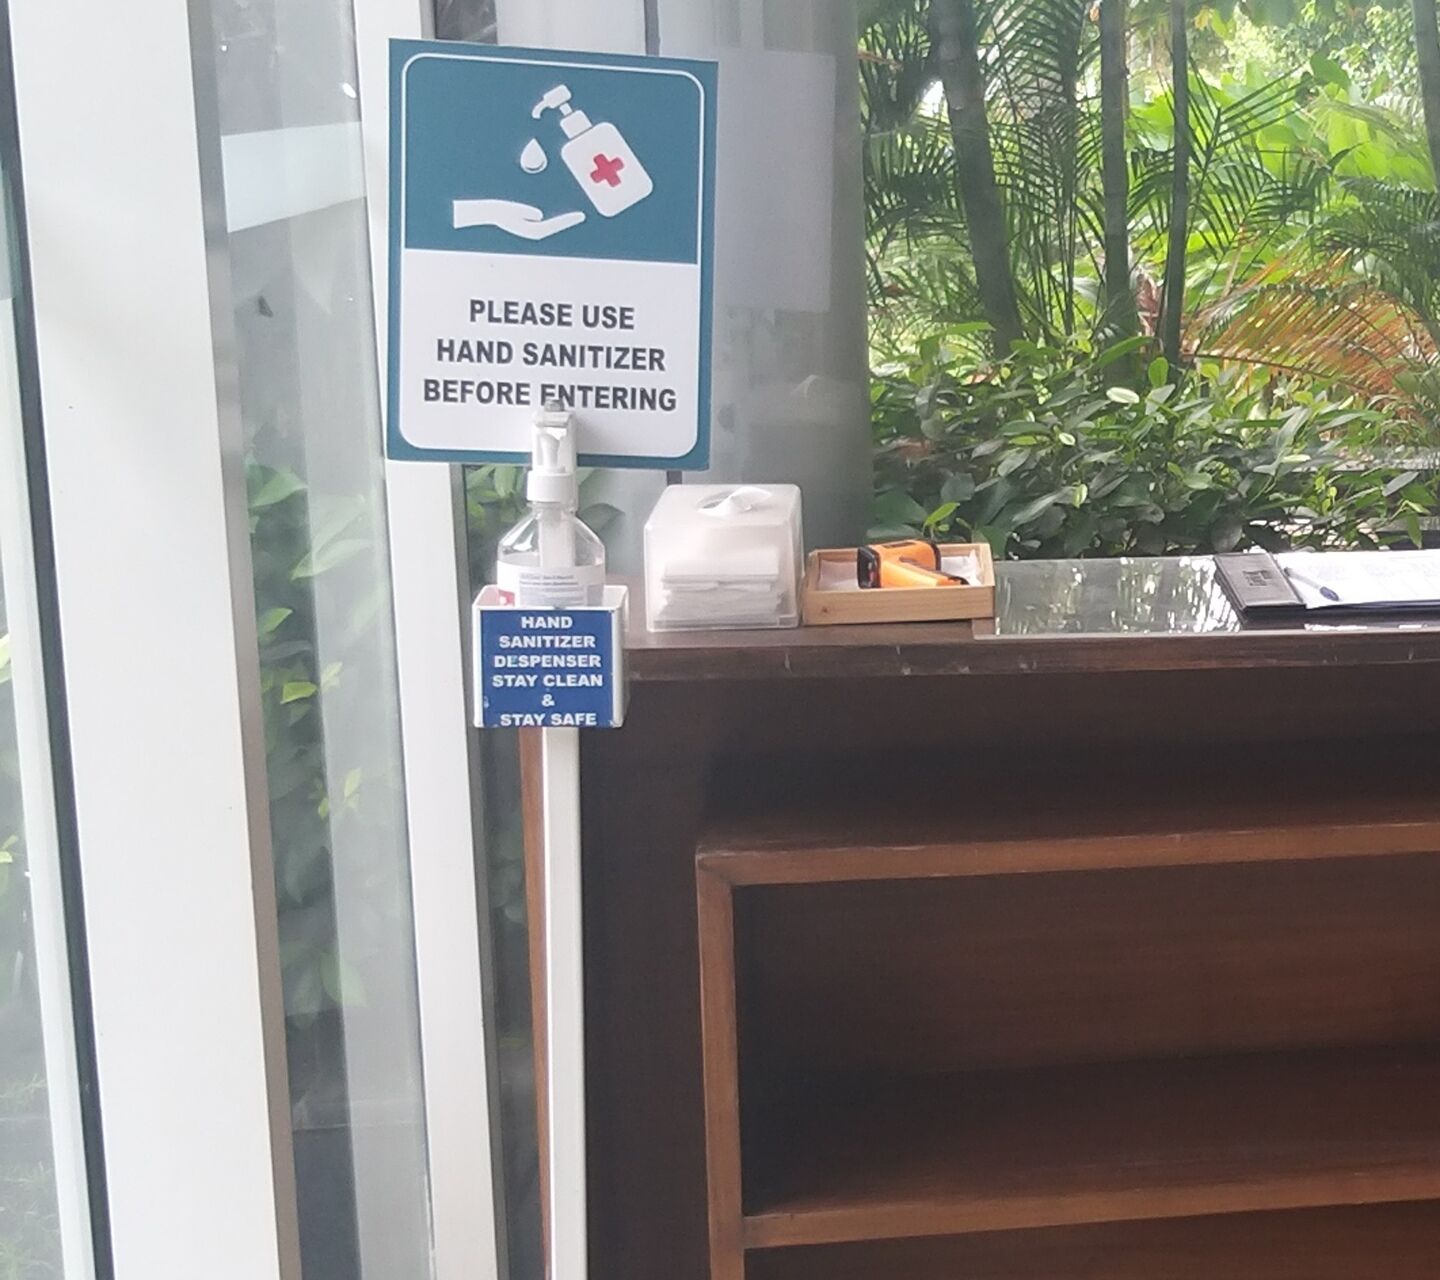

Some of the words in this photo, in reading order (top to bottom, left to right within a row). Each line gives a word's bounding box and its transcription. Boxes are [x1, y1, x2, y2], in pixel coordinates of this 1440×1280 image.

[469, 298, 573, 328] PLEASE
[582, 305, 635, 330] USE
[436, 339, 514, 365] HAND
[522, 342, 666, 372] SANITIZER
[423, 378, 531, 406] BEFORE
[540, 383, 677, 412] ENTERING
[521, 616, 573, 629] HAND
[499, 635, 596, 648] SANITIZER
[492, 674, 538, 688] STAY
[543, 674, 603, 688] CLEAN
[541, 693, 555, 707] &
[500, 713, 546, 726] STAY
[551, 713, 597, 726] SAFE
